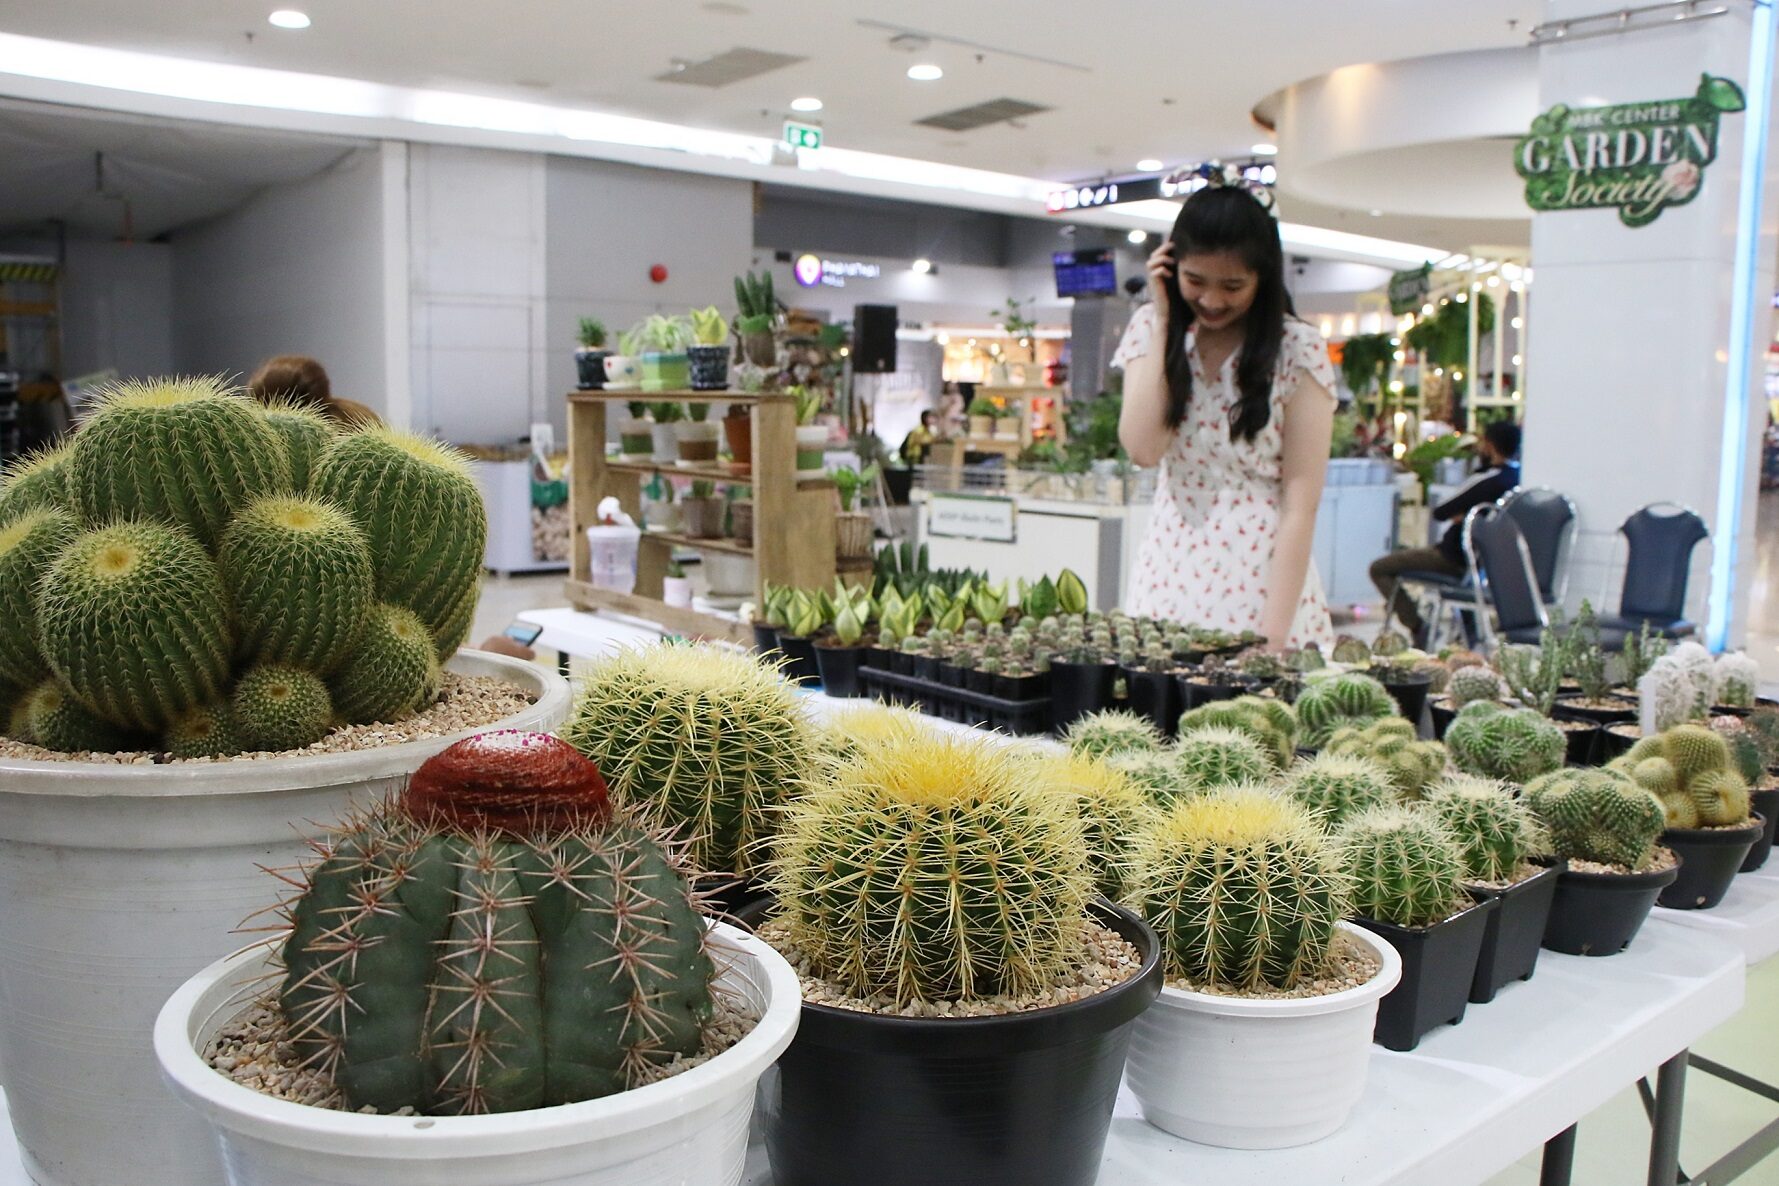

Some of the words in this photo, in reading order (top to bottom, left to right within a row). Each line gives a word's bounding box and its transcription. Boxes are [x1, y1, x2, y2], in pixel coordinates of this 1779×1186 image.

[1611, 104, 1681, 125] CENTER
[1522, 122, 1715, 172] GARDEN
[1543, 169, 1675, 218] Society
